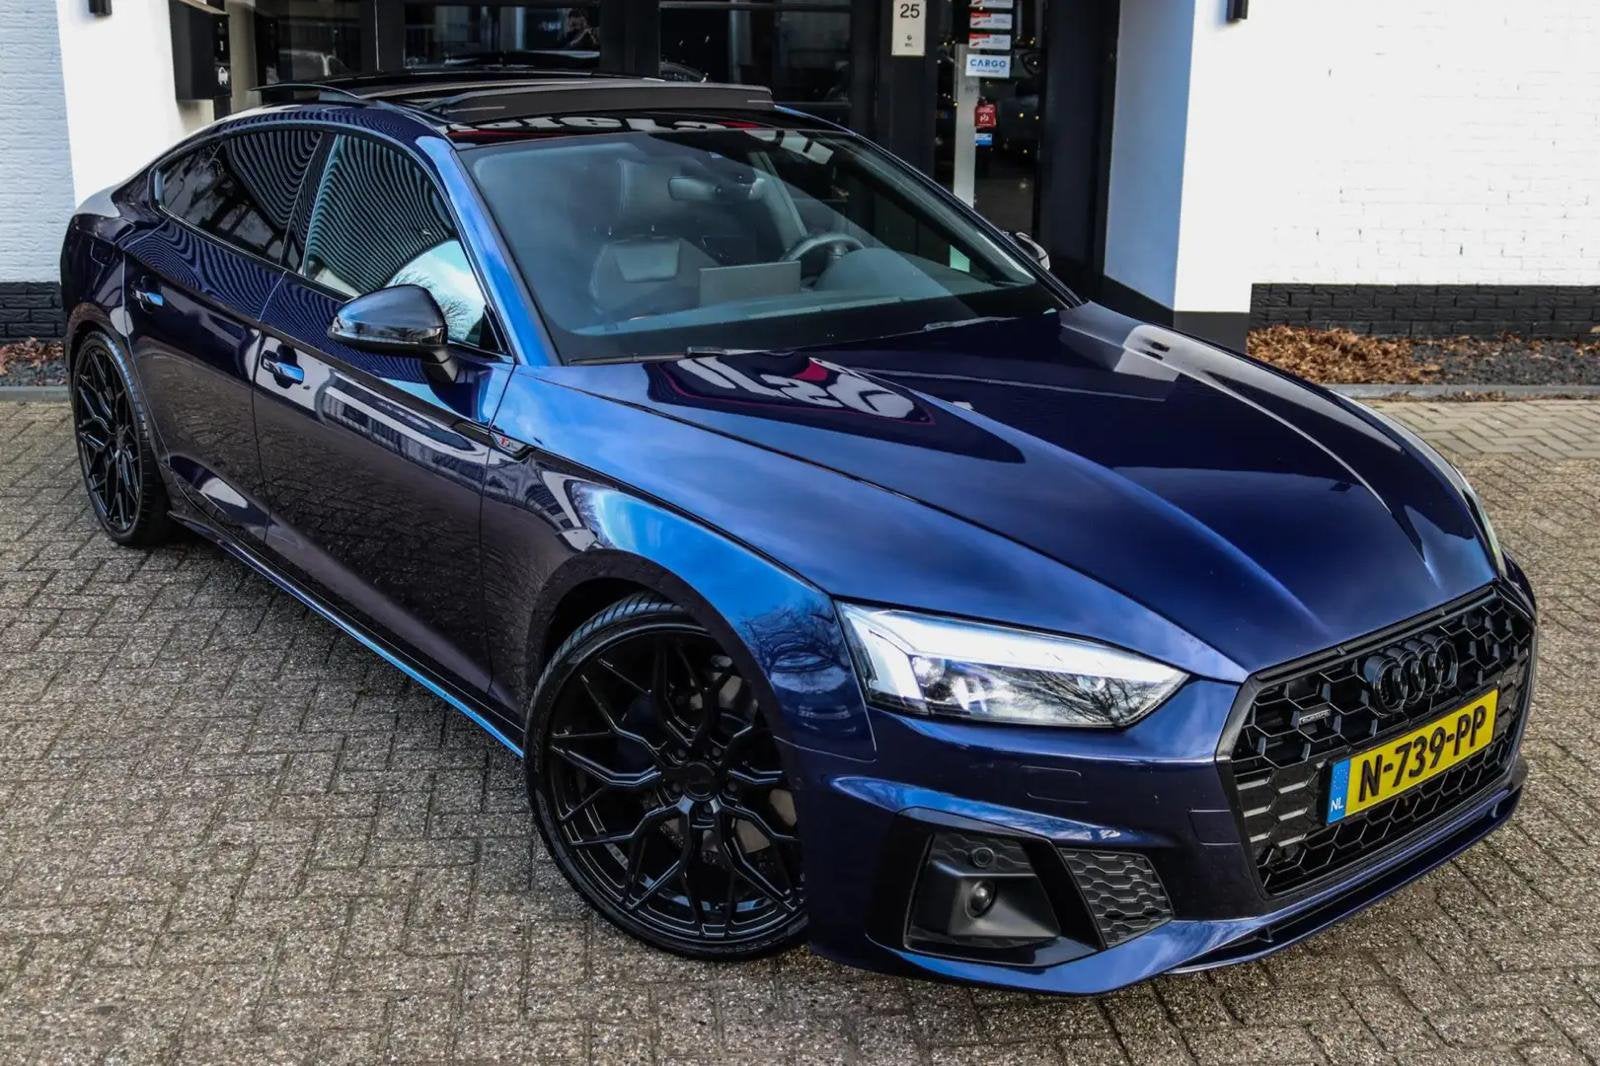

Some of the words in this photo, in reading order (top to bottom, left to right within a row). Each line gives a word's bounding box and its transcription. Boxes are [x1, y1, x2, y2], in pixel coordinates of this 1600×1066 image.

[900, 4, 920, 18] 25
[970, 59, 1006, 68] CARGO
[1358, 705, 1487, 803] N-739-PP
[1330, 797, 1344, 811] NL
